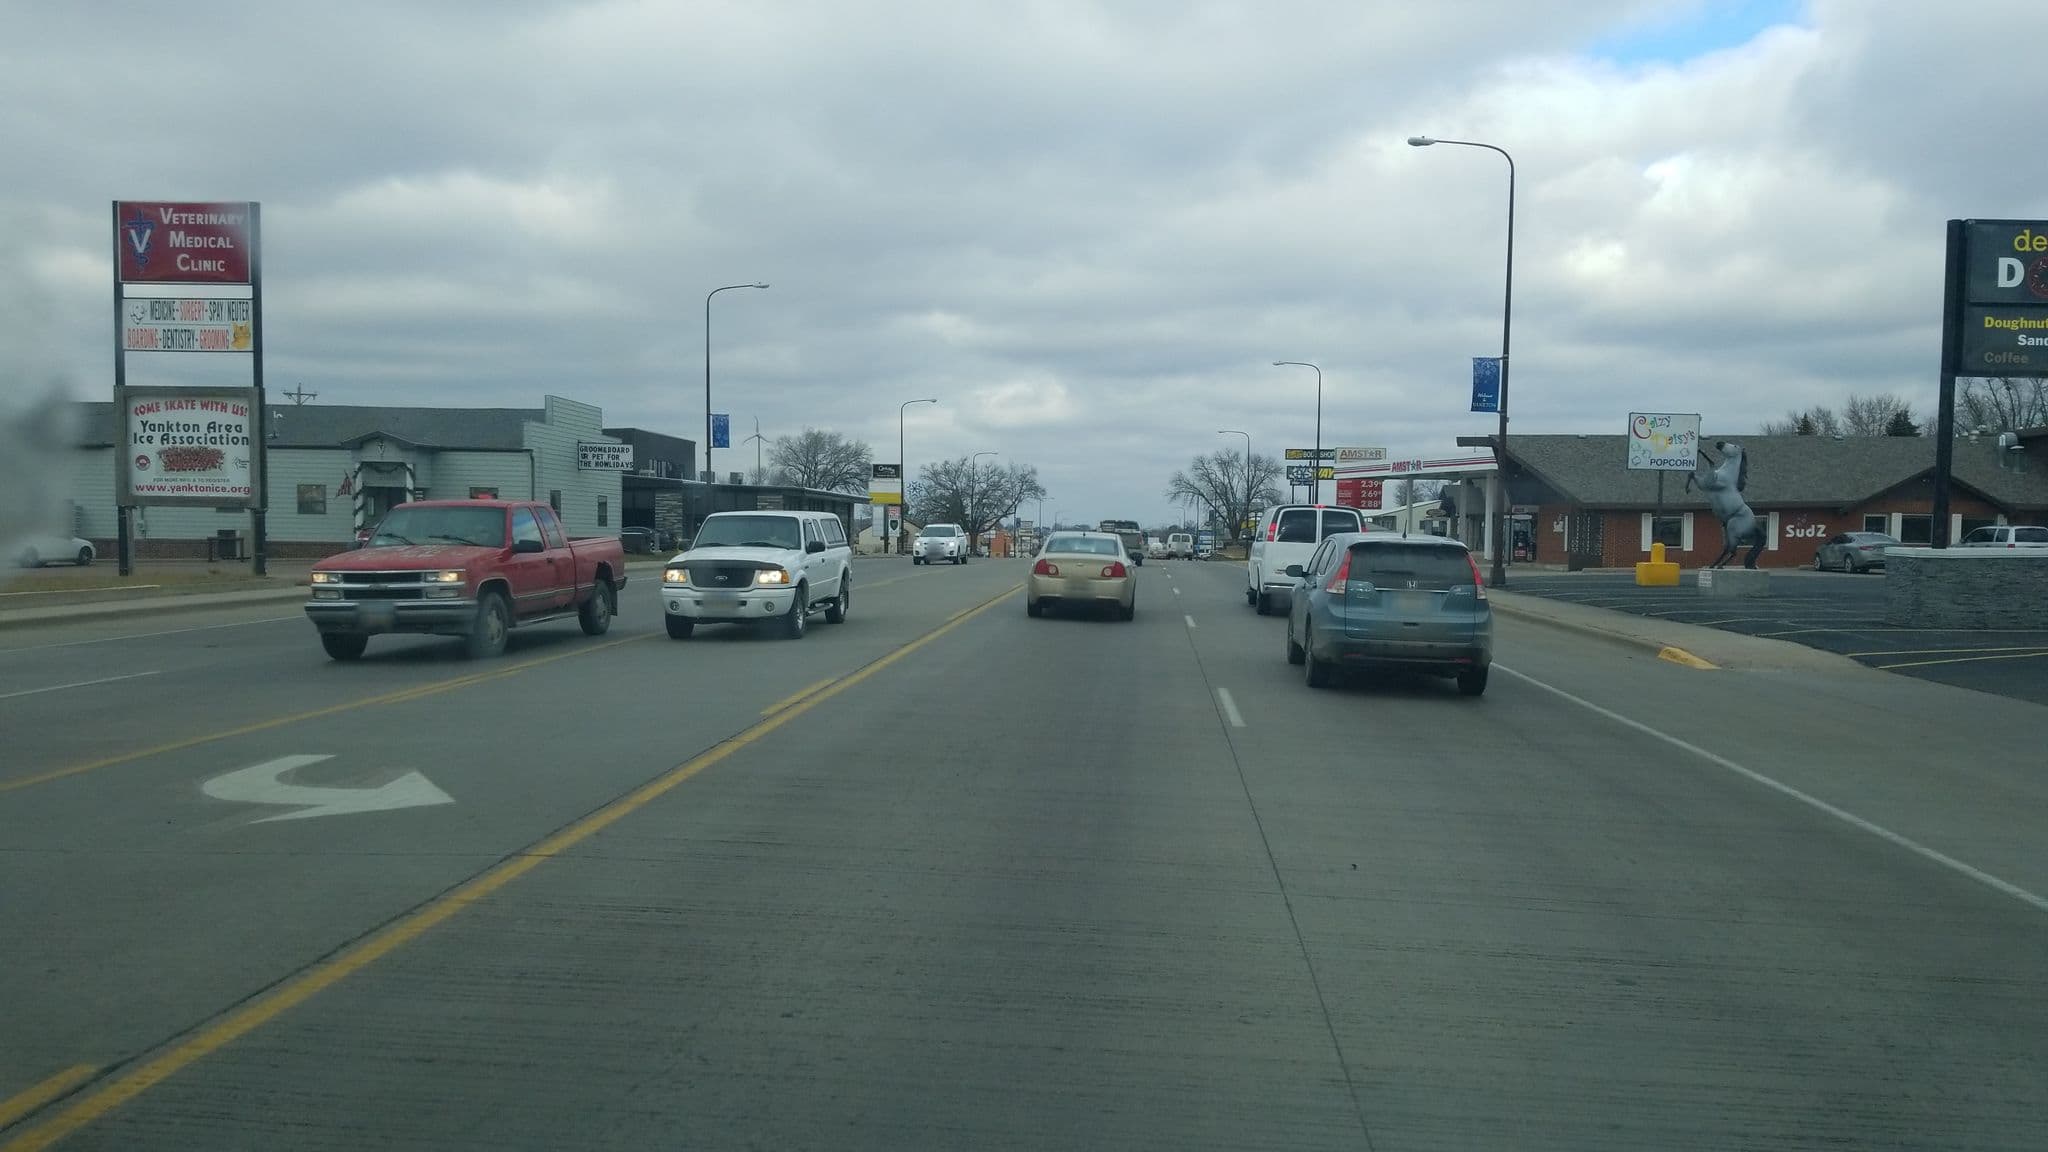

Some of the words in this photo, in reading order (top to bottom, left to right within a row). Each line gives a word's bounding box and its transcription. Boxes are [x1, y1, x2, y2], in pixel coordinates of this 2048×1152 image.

[169, 231, 234, 249] MEDICAL
[177, 253, 225, 272] CLINIC
[134, 402, 161, 416] COME
[164, 400, 197, 411] SKATE
[200, 400, 228, 413] WITH
[140, 420, 200, 434] Yankton
[207, 421, 243, 434] Area
[133, 432, 154, 444] Ice
[160, 433, 249, 445] Association
[1650, 459, 1695, 467] POPCORN
[136, 483, 251, 495] www.yanktonice.org
